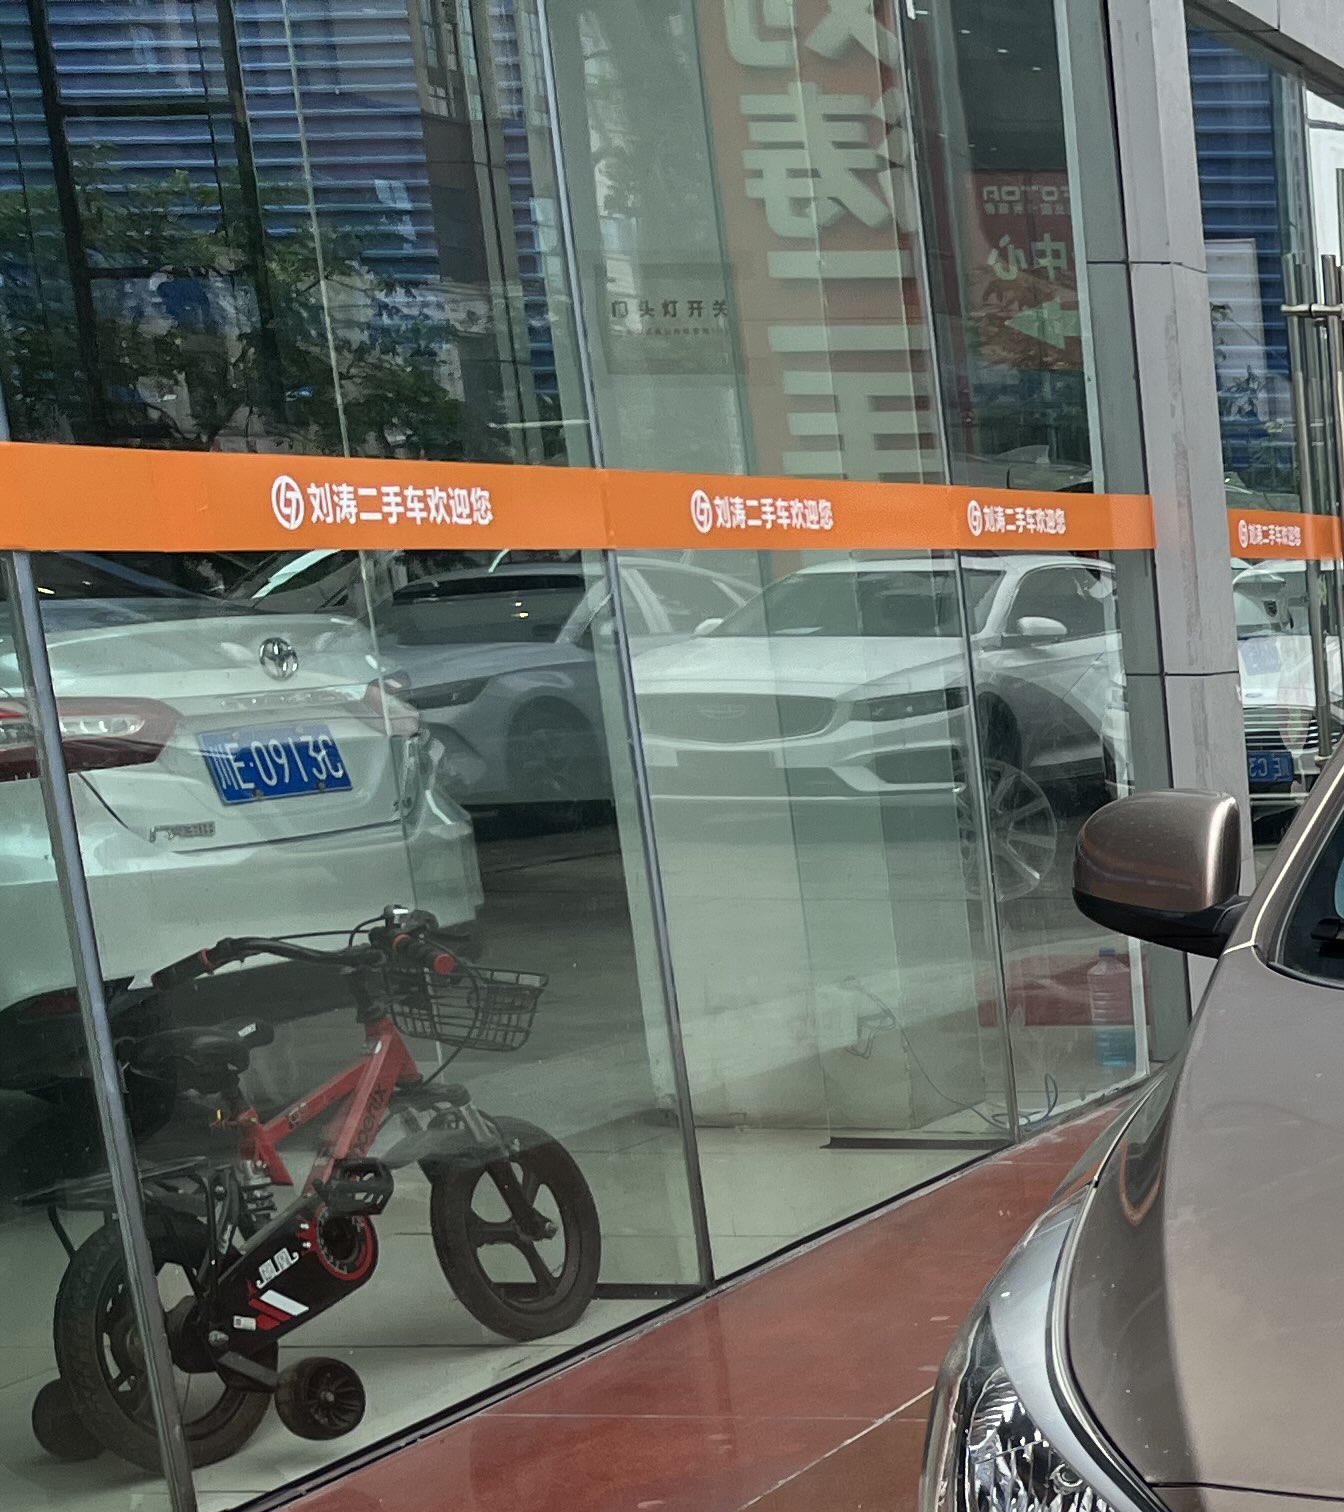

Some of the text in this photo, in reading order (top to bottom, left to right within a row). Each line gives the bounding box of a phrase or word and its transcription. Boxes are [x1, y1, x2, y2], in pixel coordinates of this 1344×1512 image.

[307, 483, 493, 525] 刘涛二手车欢迎您
[714, 496, 834, 530] 刘涛二手车欢迎您
